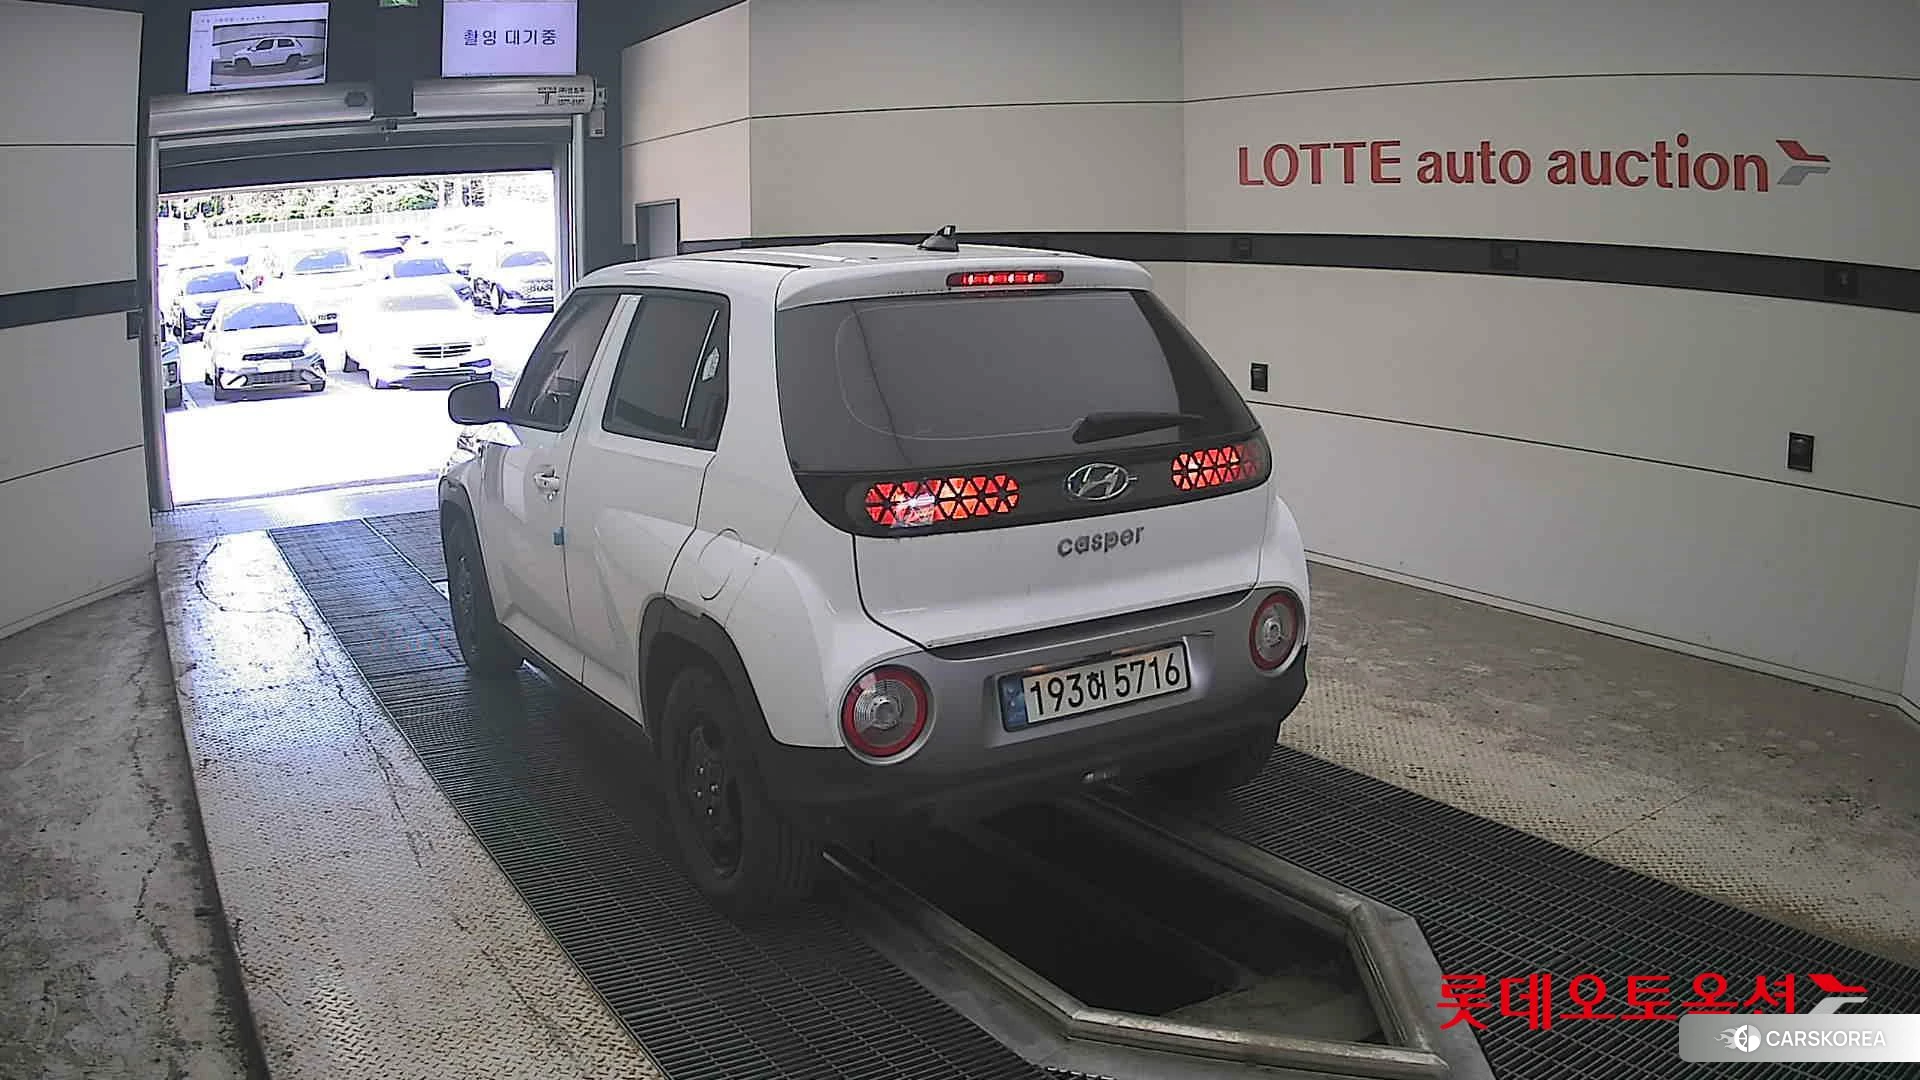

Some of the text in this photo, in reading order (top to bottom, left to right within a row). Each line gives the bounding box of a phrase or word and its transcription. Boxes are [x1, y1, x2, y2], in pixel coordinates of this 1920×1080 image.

[505, 29, 557, 46] 대기중
[1238, 133, 1769, 192] LOTTE auto auction
[1058, 526, 1145, 558] casper
